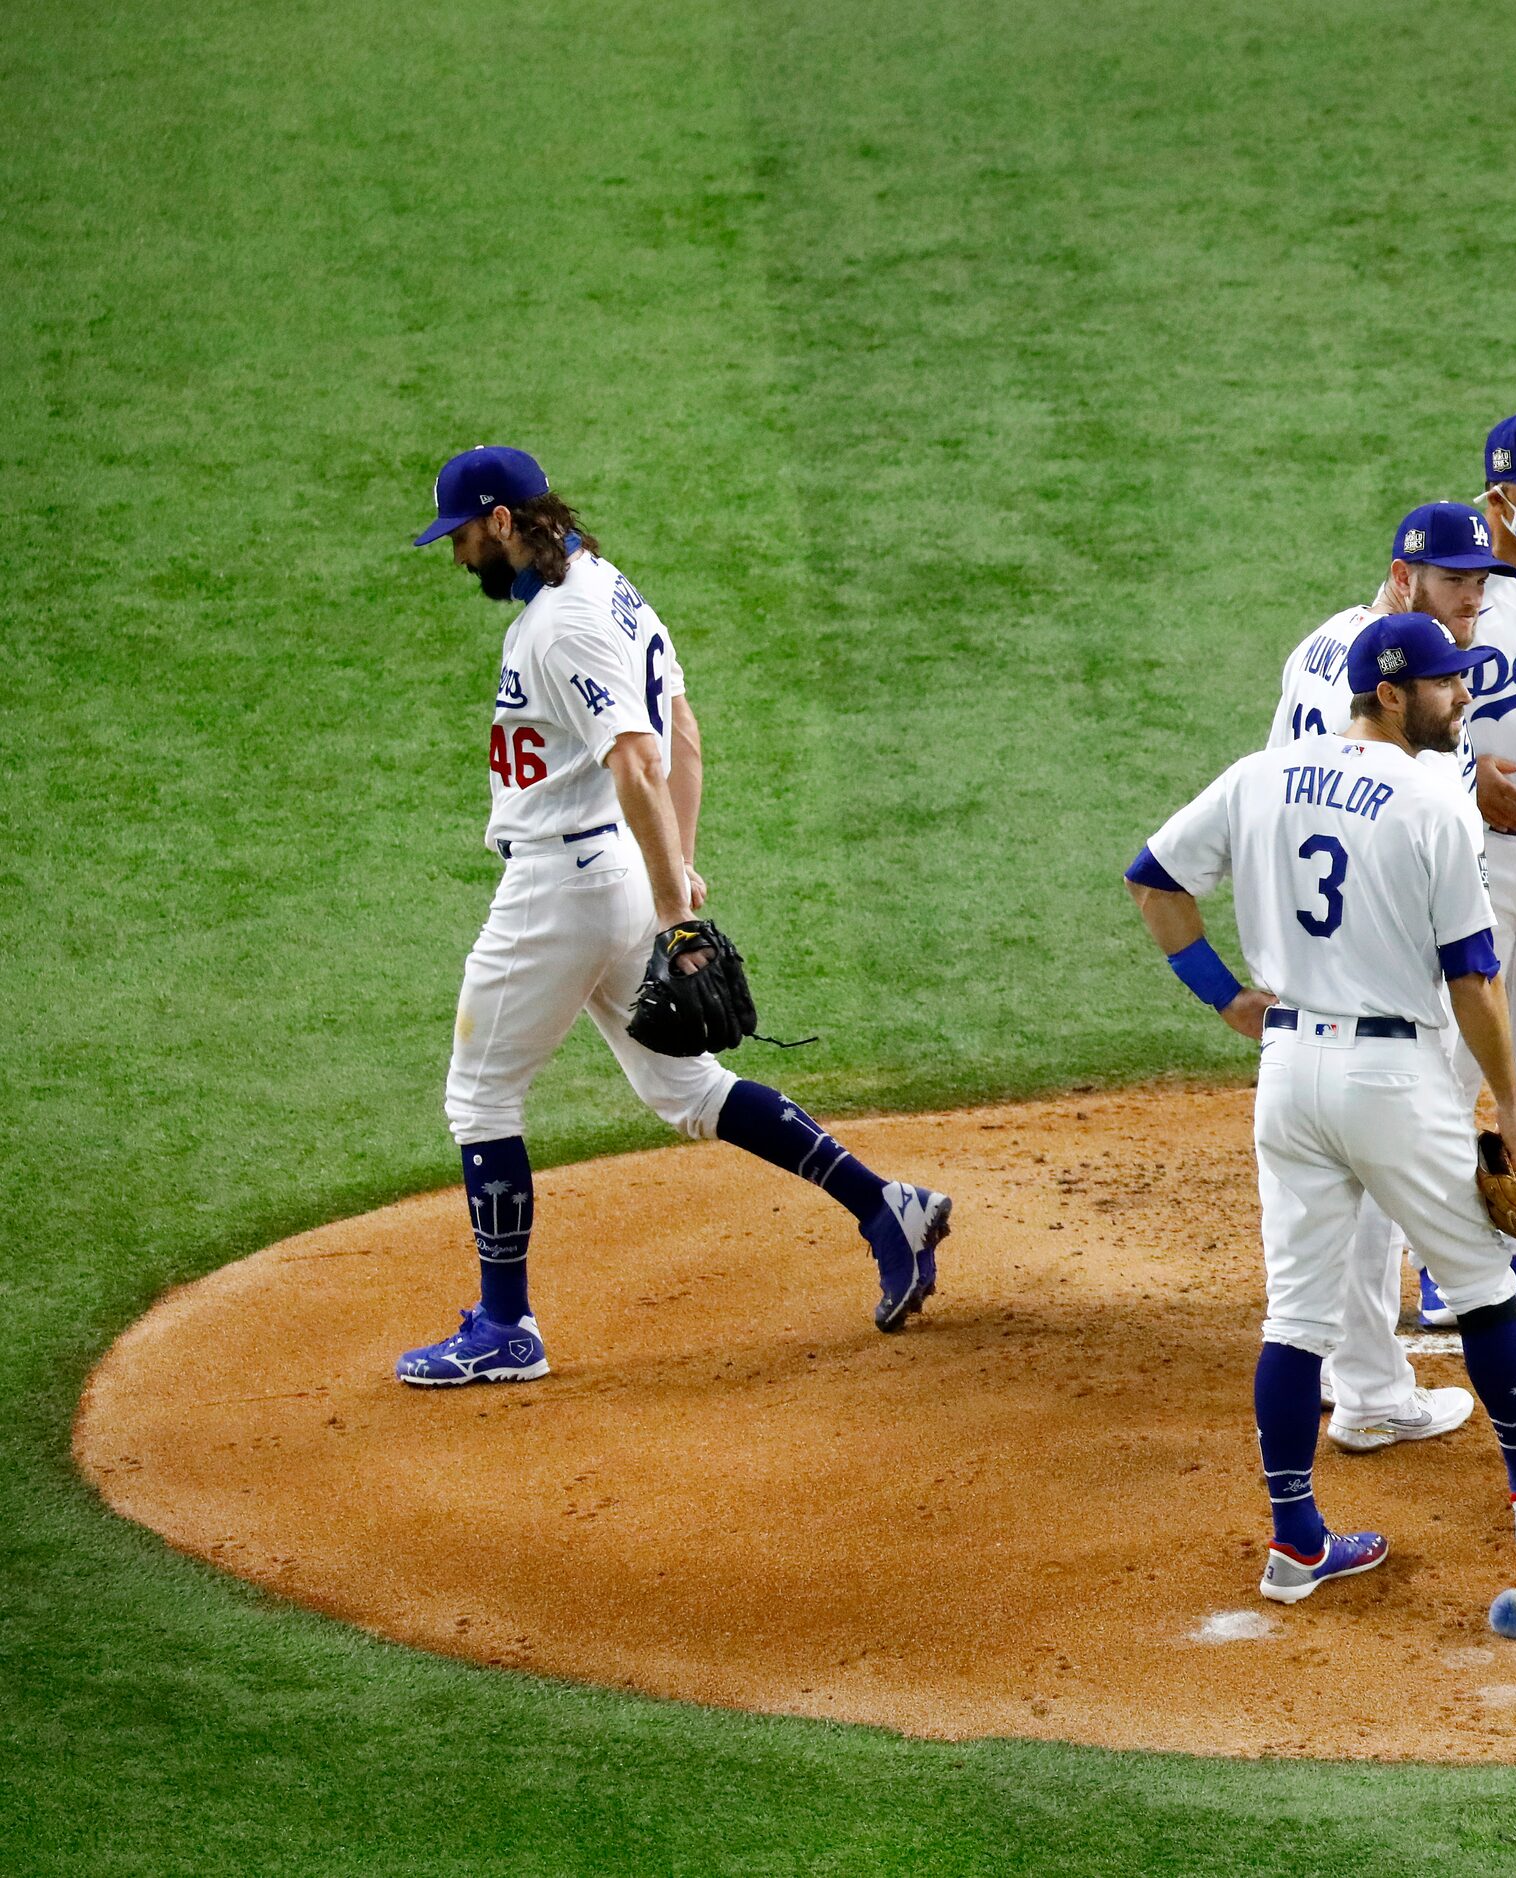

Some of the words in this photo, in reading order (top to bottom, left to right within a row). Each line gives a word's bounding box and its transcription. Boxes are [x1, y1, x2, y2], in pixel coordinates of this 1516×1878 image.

[1469, 516, 1489, 547] LA
[1379, 651, 1401, 667] WORLD
[1381, 658, 1404, 672] SERIES
[570, 674, 616, 716] LA
[489, 724, 548, 790] 46
[1283, 766, 1394, 821] TAYLOR
[1296, 833, 1349, 939] 3
[1267, 1565, 1275, 1580] 3
